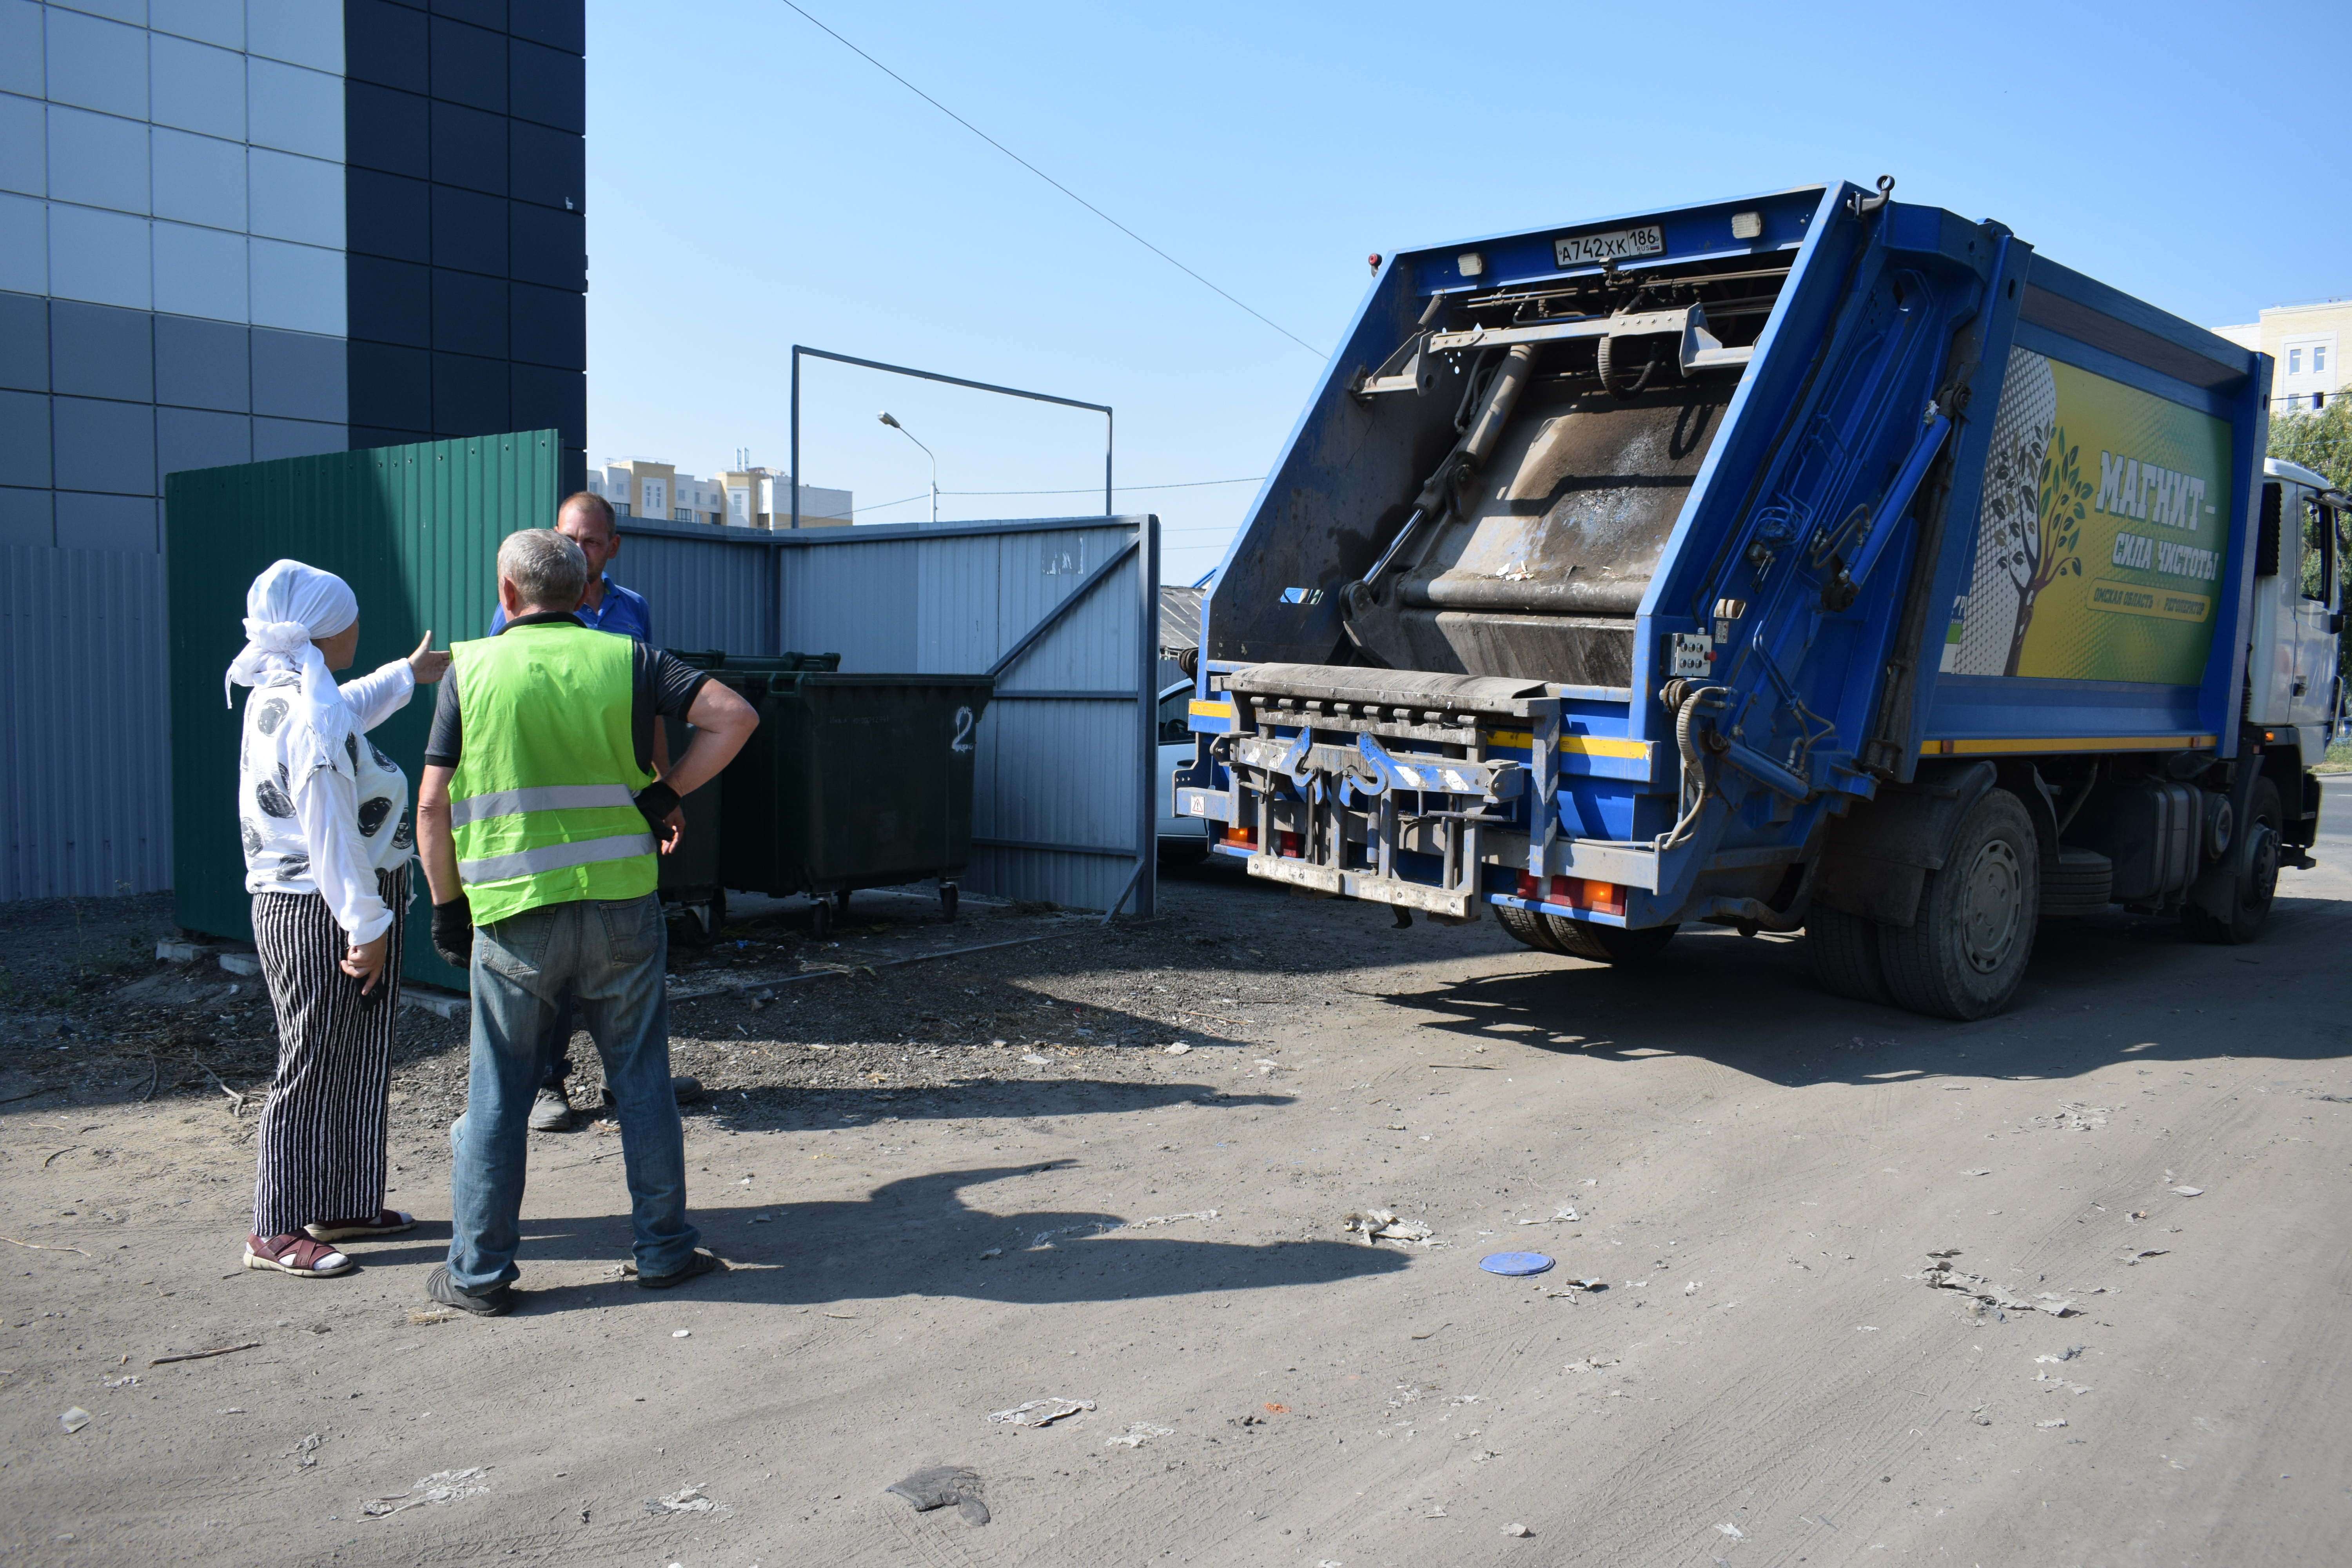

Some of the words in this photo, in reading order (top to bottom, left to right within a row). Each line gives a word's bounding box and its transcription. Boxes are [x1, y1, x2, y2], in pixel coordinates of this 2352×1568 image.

[1630, 229, 1655, 247] 186
[2112, 532, 2153, 570] СИЛА
[2158, 540, 2220, 581] ЧИСТОТЫ
[2094, 587, 2124, 605] ОМСКАЯ
[2123, 591, 2153, 609] ОБЛАСТЬ
[952, 706, 973, 753] 2
